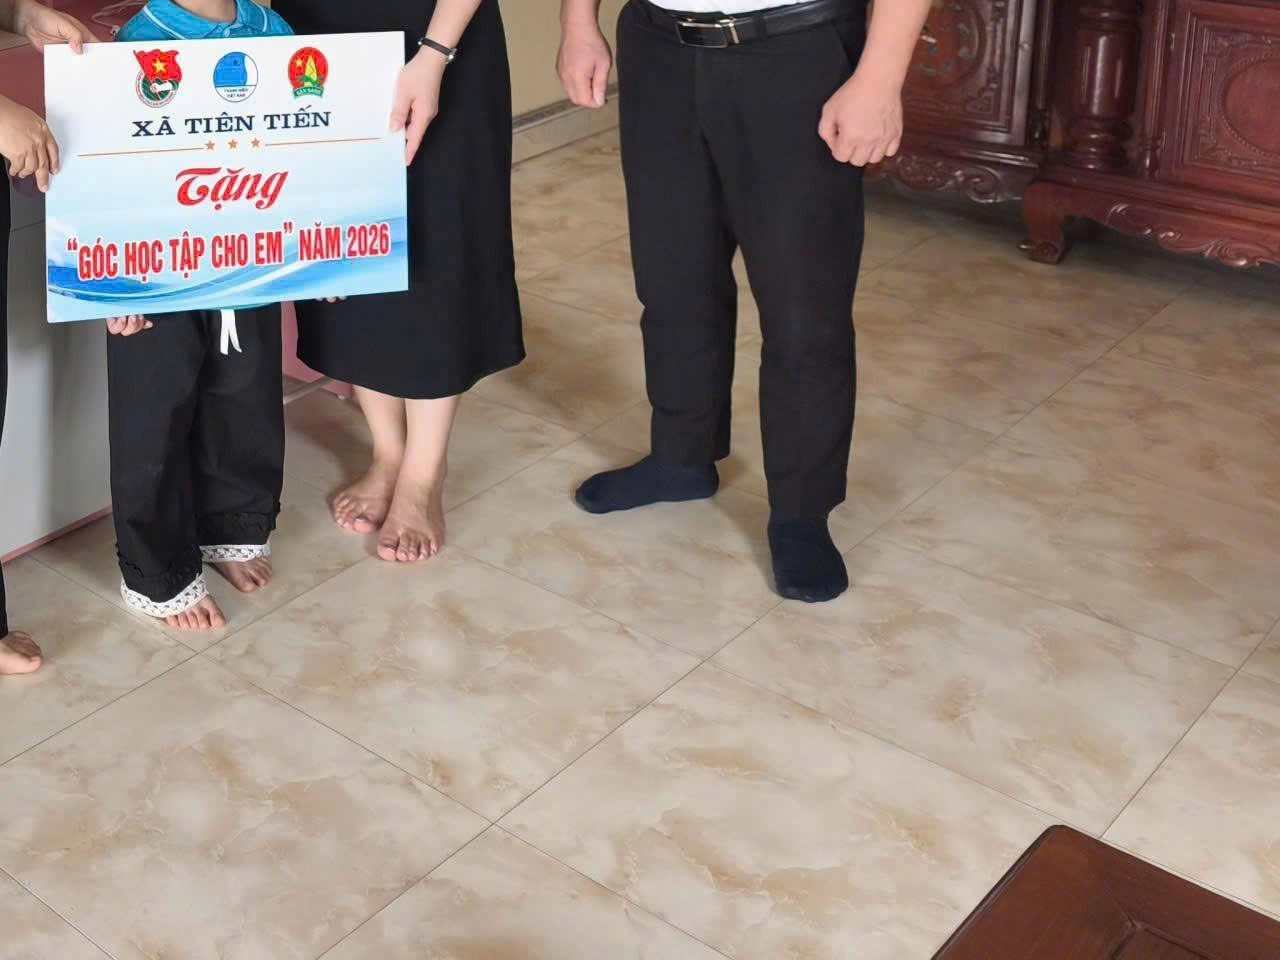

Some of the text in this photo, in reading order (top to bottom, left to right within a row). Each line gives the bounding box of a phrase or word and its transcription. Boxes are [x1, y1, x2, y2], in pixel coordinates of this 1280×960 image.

[131, 104, 332, 137] XÃ TIÊN TIẾN
[175, 167, 289, 211] Tặng
[67, 221, 389, 282] “GÓC HỌC TẬP CHO EM” NĂM 2026
